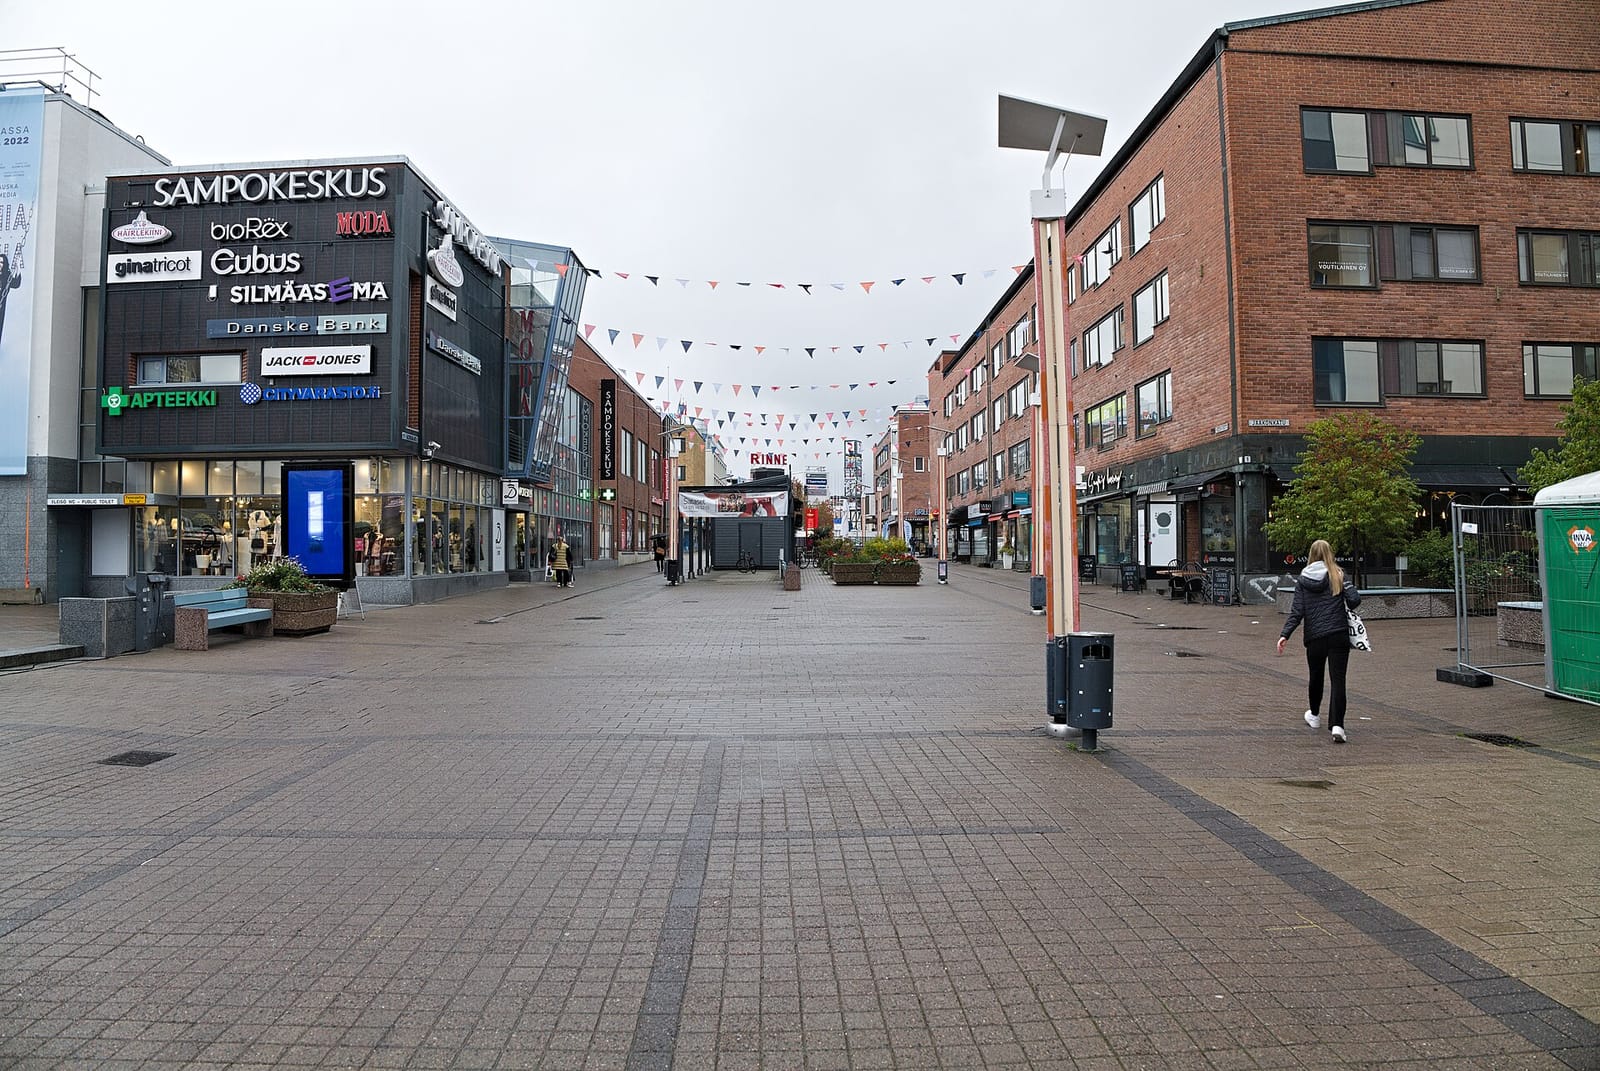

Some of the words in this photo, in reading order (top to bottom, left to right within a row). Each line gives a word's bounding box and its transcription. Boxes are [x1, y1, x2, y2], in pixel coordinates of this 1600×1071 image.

[3, 136, 29, 145] 2022
[153, 167, 387, 207] SAMPOKESKUS
[336, 210, 391, 235] MODA
[210, 245, 301, 275] Cubus
[230, 277, 389, 303] SILMÄASEMA
[227, 320, 310, 334] Danske
[323, 317, 380, 331] Bank
[266, 356, 303, 367] JACK
[131, 389, 216, 409] APTEEKKI
[263, 386, 381, 401] CITYVARASTO.fi
[604, 391, 613, 478] SAMPOKESKUS
[750, 453, 788, 465] RINNE
